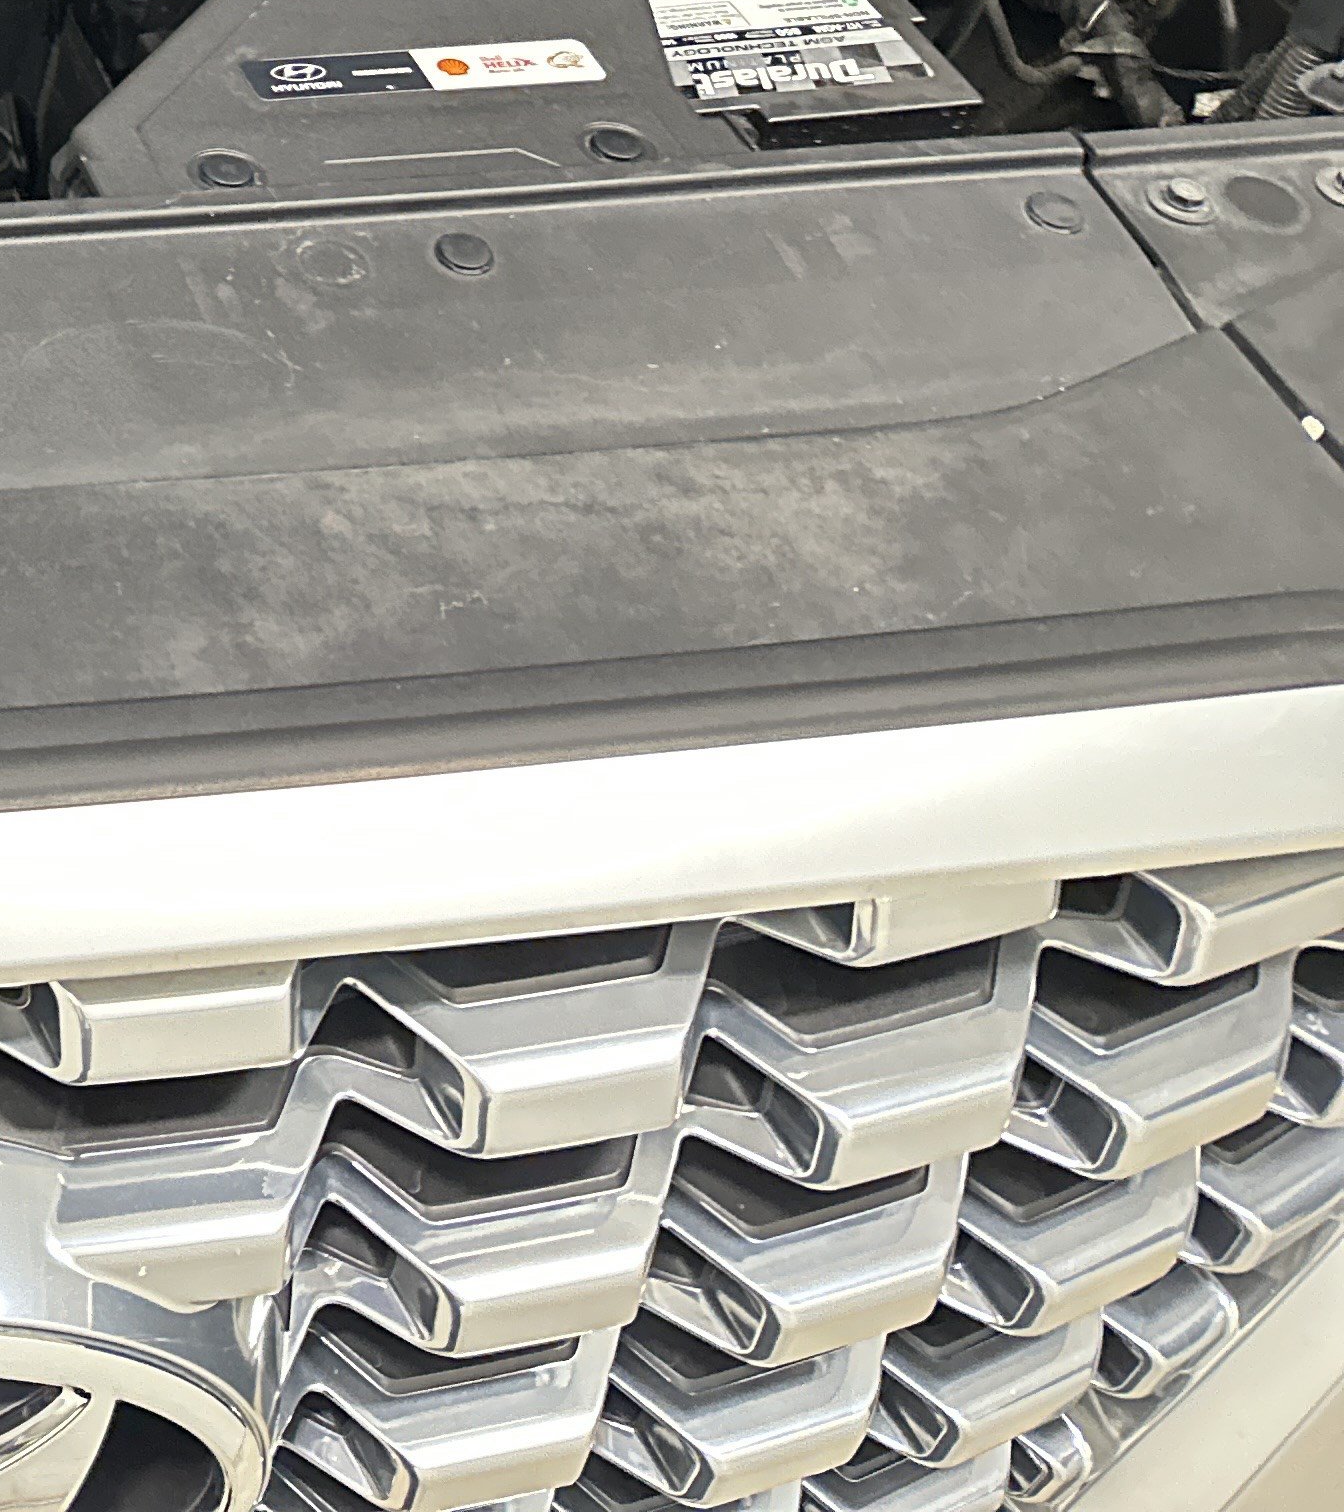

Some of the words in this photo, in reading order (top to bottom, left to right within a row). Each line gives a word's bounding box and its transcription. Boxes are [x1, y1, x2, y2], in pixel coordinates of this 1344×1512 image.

[803, 35, 845, 46] AGM
[672, 40, 798, 58] TECHNOLOGY
[482, 58, 538, 69] HELIX
[690, 58, 875, 96] Duralast
[271, 80, 343, 93] HYUNDAI
